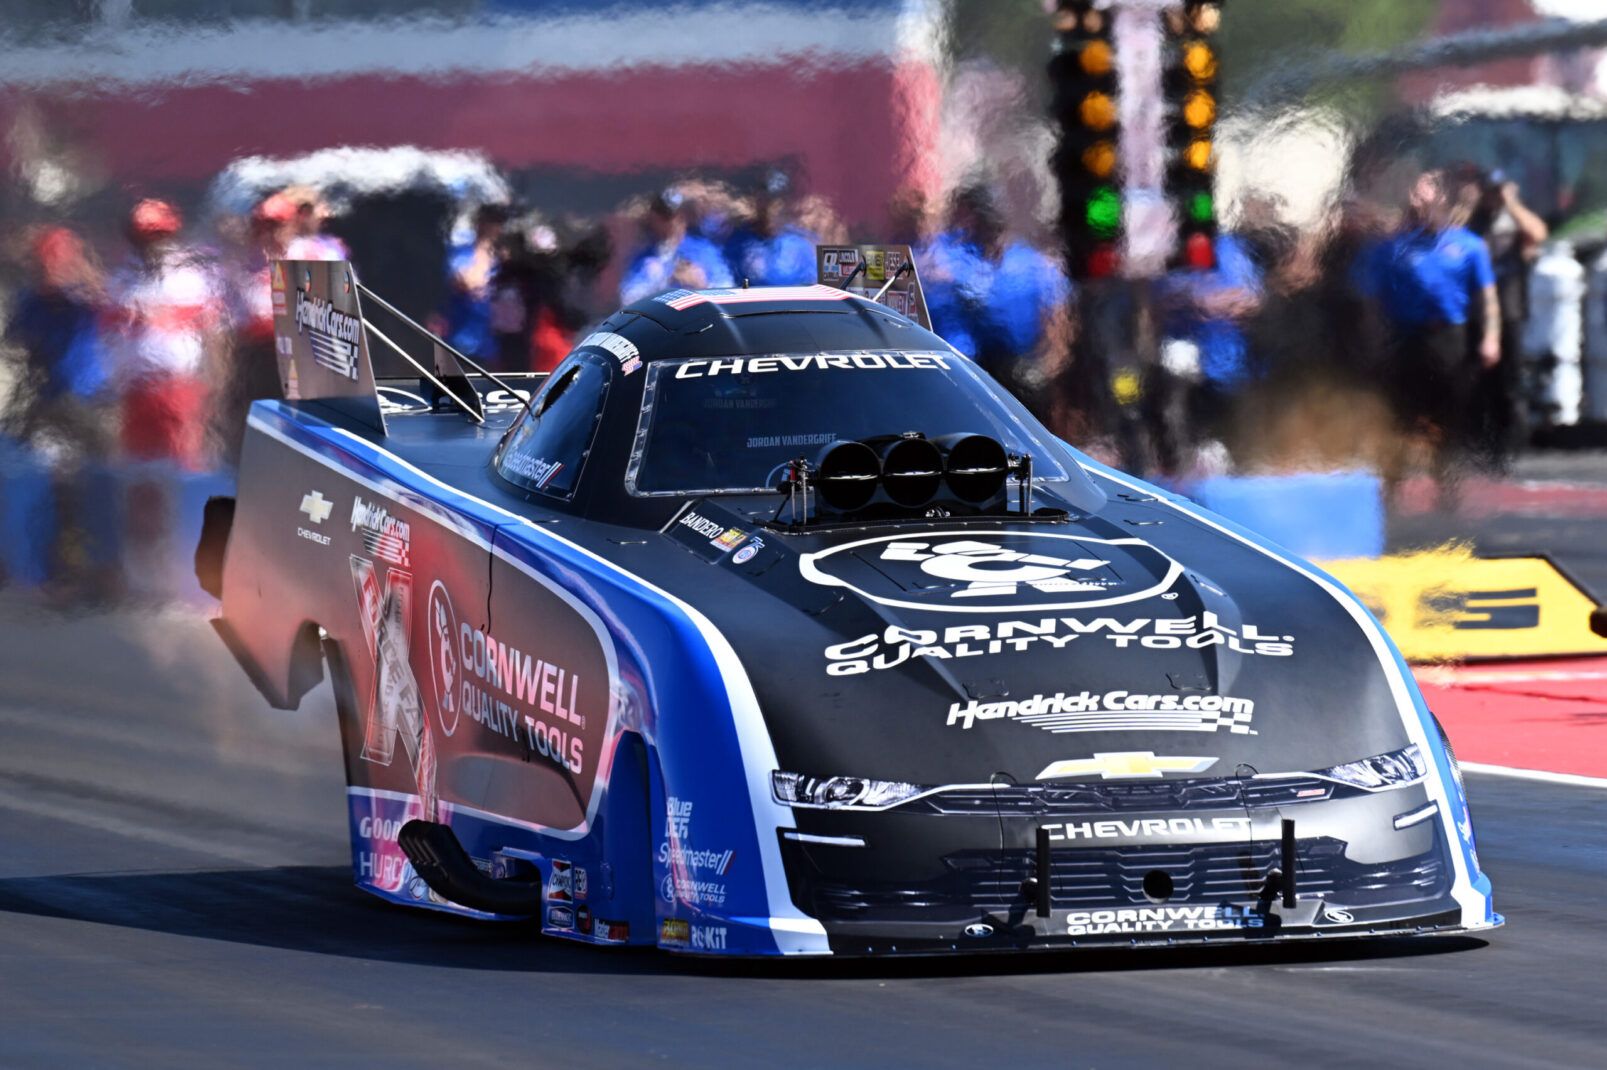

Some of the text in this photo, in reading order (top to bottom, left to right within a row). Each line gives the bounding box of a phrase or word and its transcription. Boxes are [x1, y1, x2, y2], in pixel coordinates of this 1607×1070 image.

[675, 353, 952, 380] CHEVROLET
[746, 432, 838, 448] JORDAN VANDERGRIFF
[297, 527, 332, 546] CHEVROLET
[679, 512, 725, 540] BANDERO
[824, 611, 1281, 660] CORNWELL
[825, 629, 1295, 676] QUALITY TOOLS
[460, 622, 582, 727] CORNWELL
[462, 680, 584, 775] QUALITY TOOLS
[666, 796, 693, 817] Blue
[360, 816, 401, 842] GOOD
[1041, 817, 1252, 841] CHEVROLET
[1066, 906, 1259, 925] CORNWELL
[1067, 917, 1264, 935] QUALITY TOOLS
